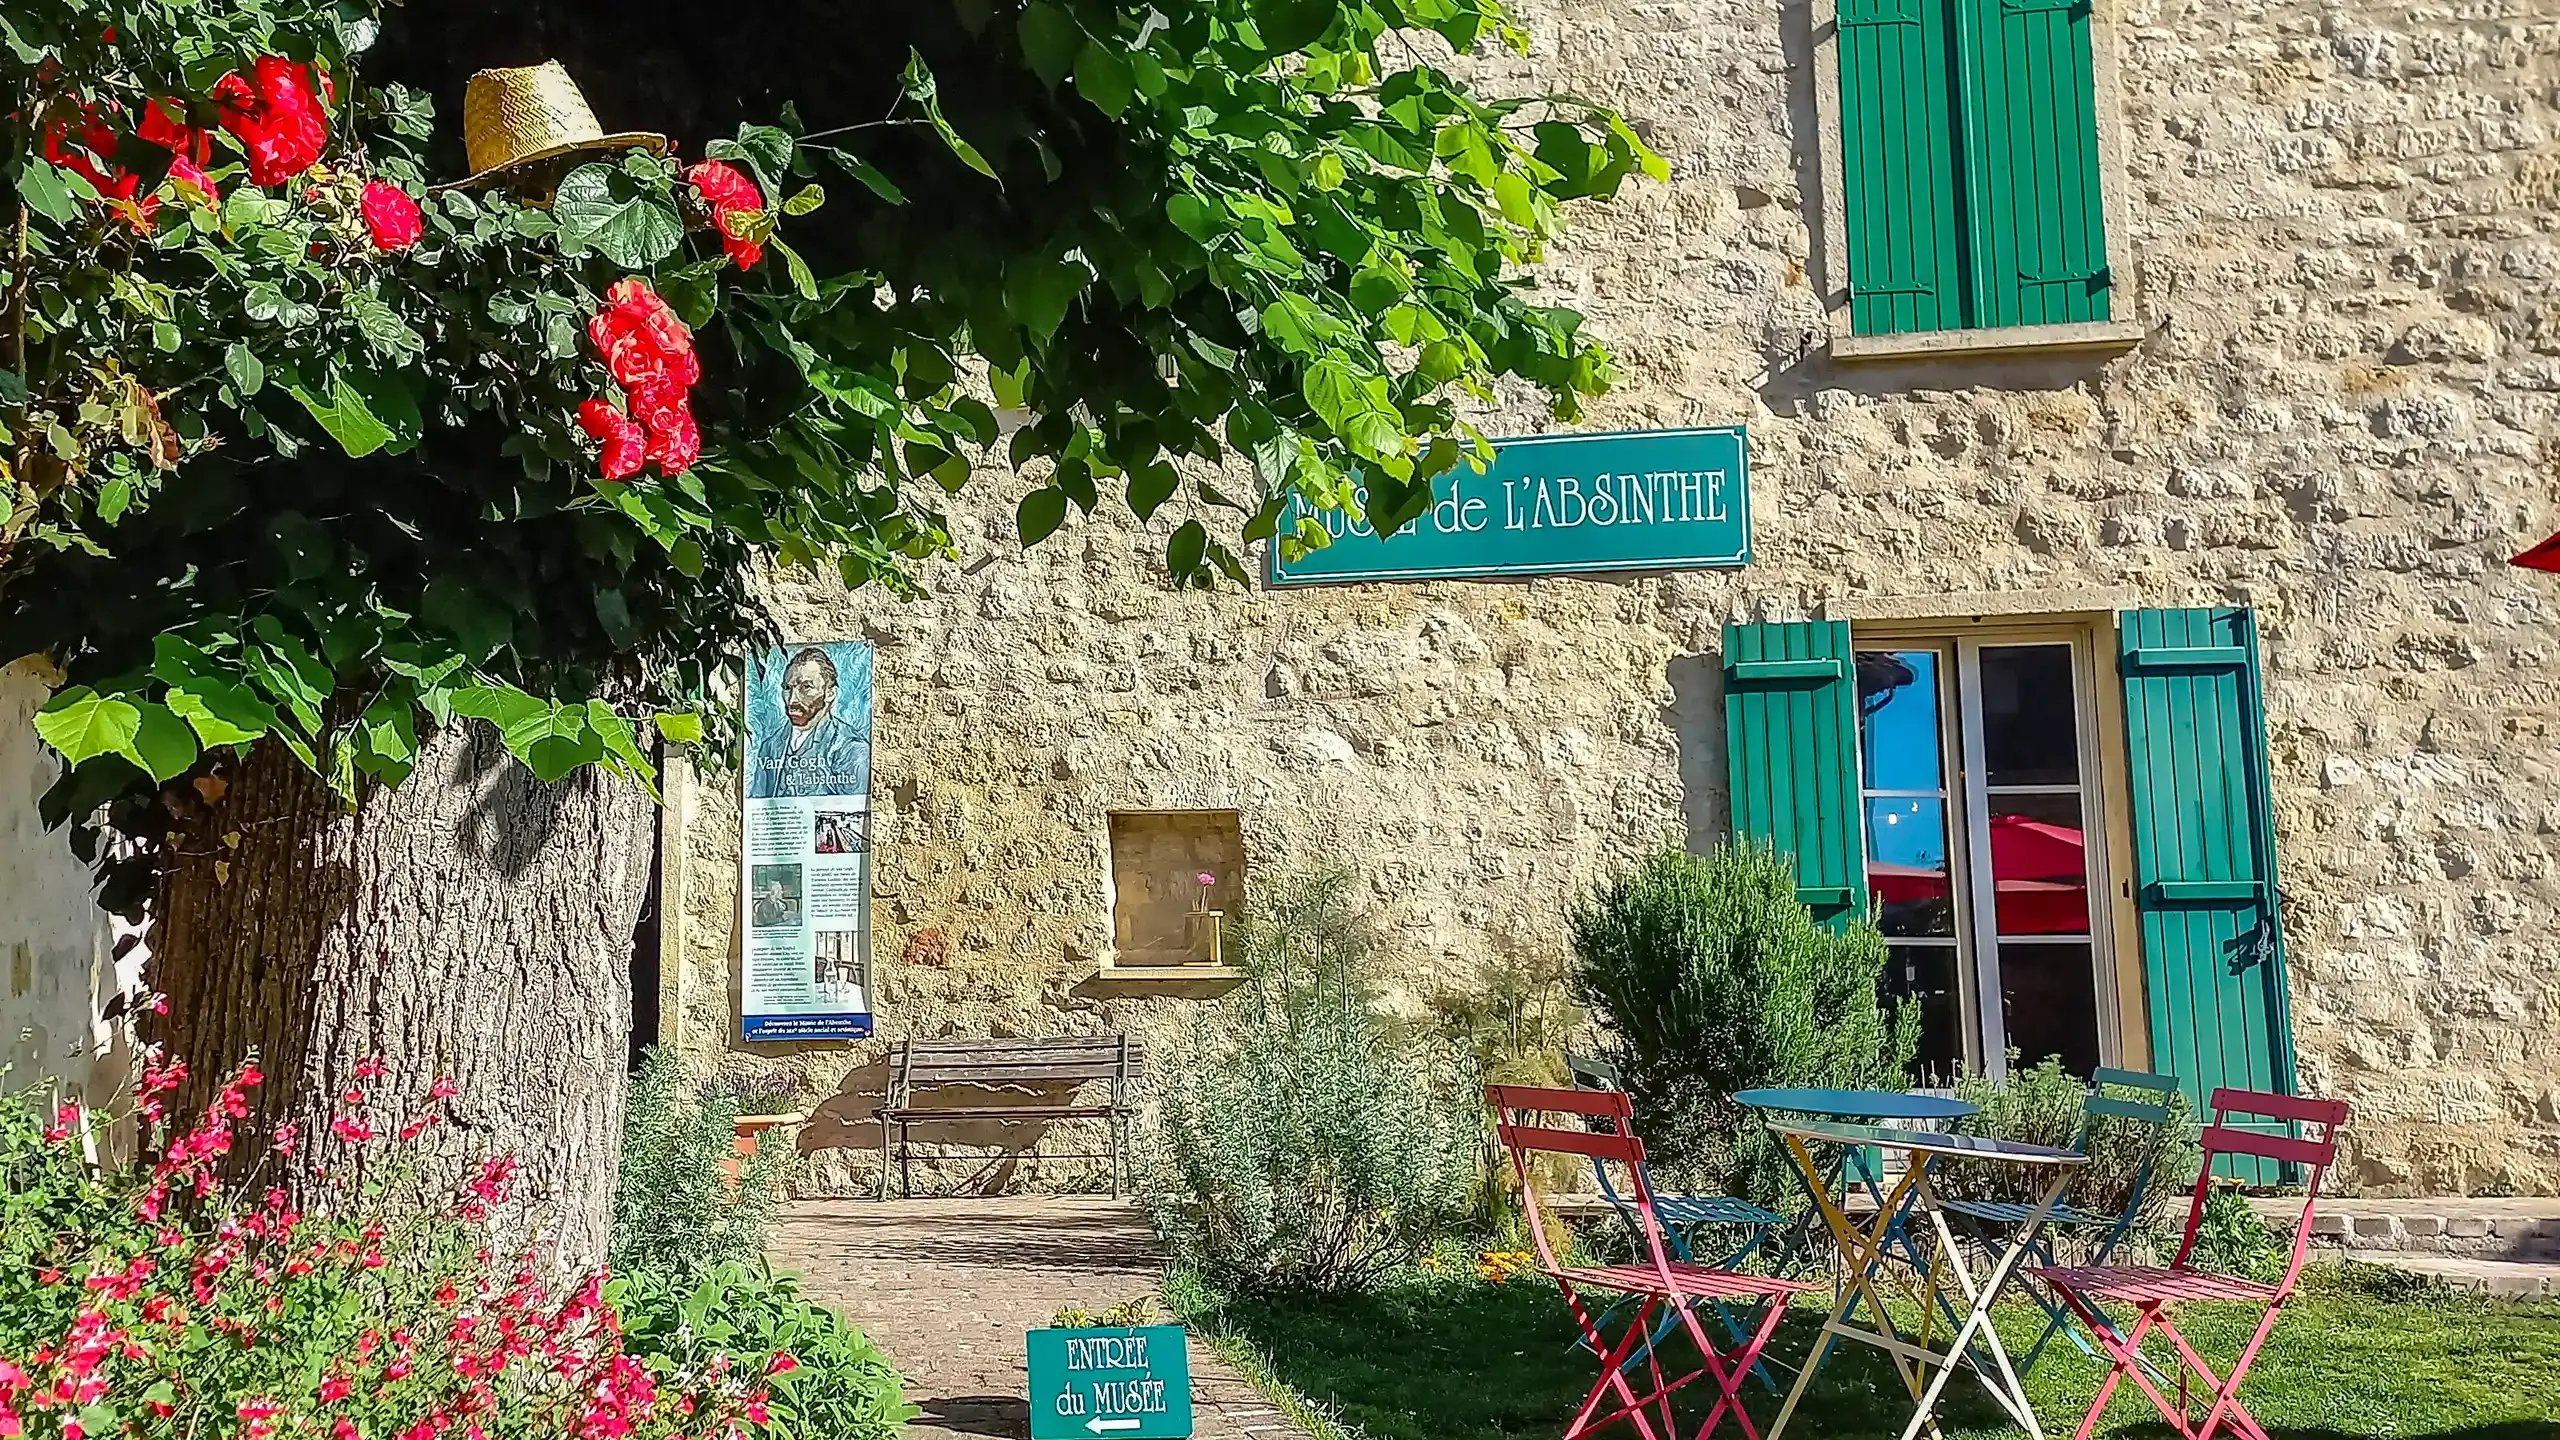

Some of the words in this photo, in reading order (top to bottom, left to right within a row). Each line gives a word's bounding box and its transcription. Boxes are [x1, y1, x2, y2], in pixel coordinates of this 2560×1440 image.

[1292, 486, 1418, 539] MUS
[1433, 479, 1488, 533] de
[1502, 467, 1728, 533] L'ABSINTHE
[758, 757, 783, 770] Van
[788, 754, 826, 771] Gogh
[785, 774, 796, 786] &
[798, 771, 857, 786] l'absinthe
[1066, 1328, 1149, 1371] ENTRÉE
[1056, 1381, 1086, 1415] du
[1093, 1371, 1167, 1414] MUSÉE
